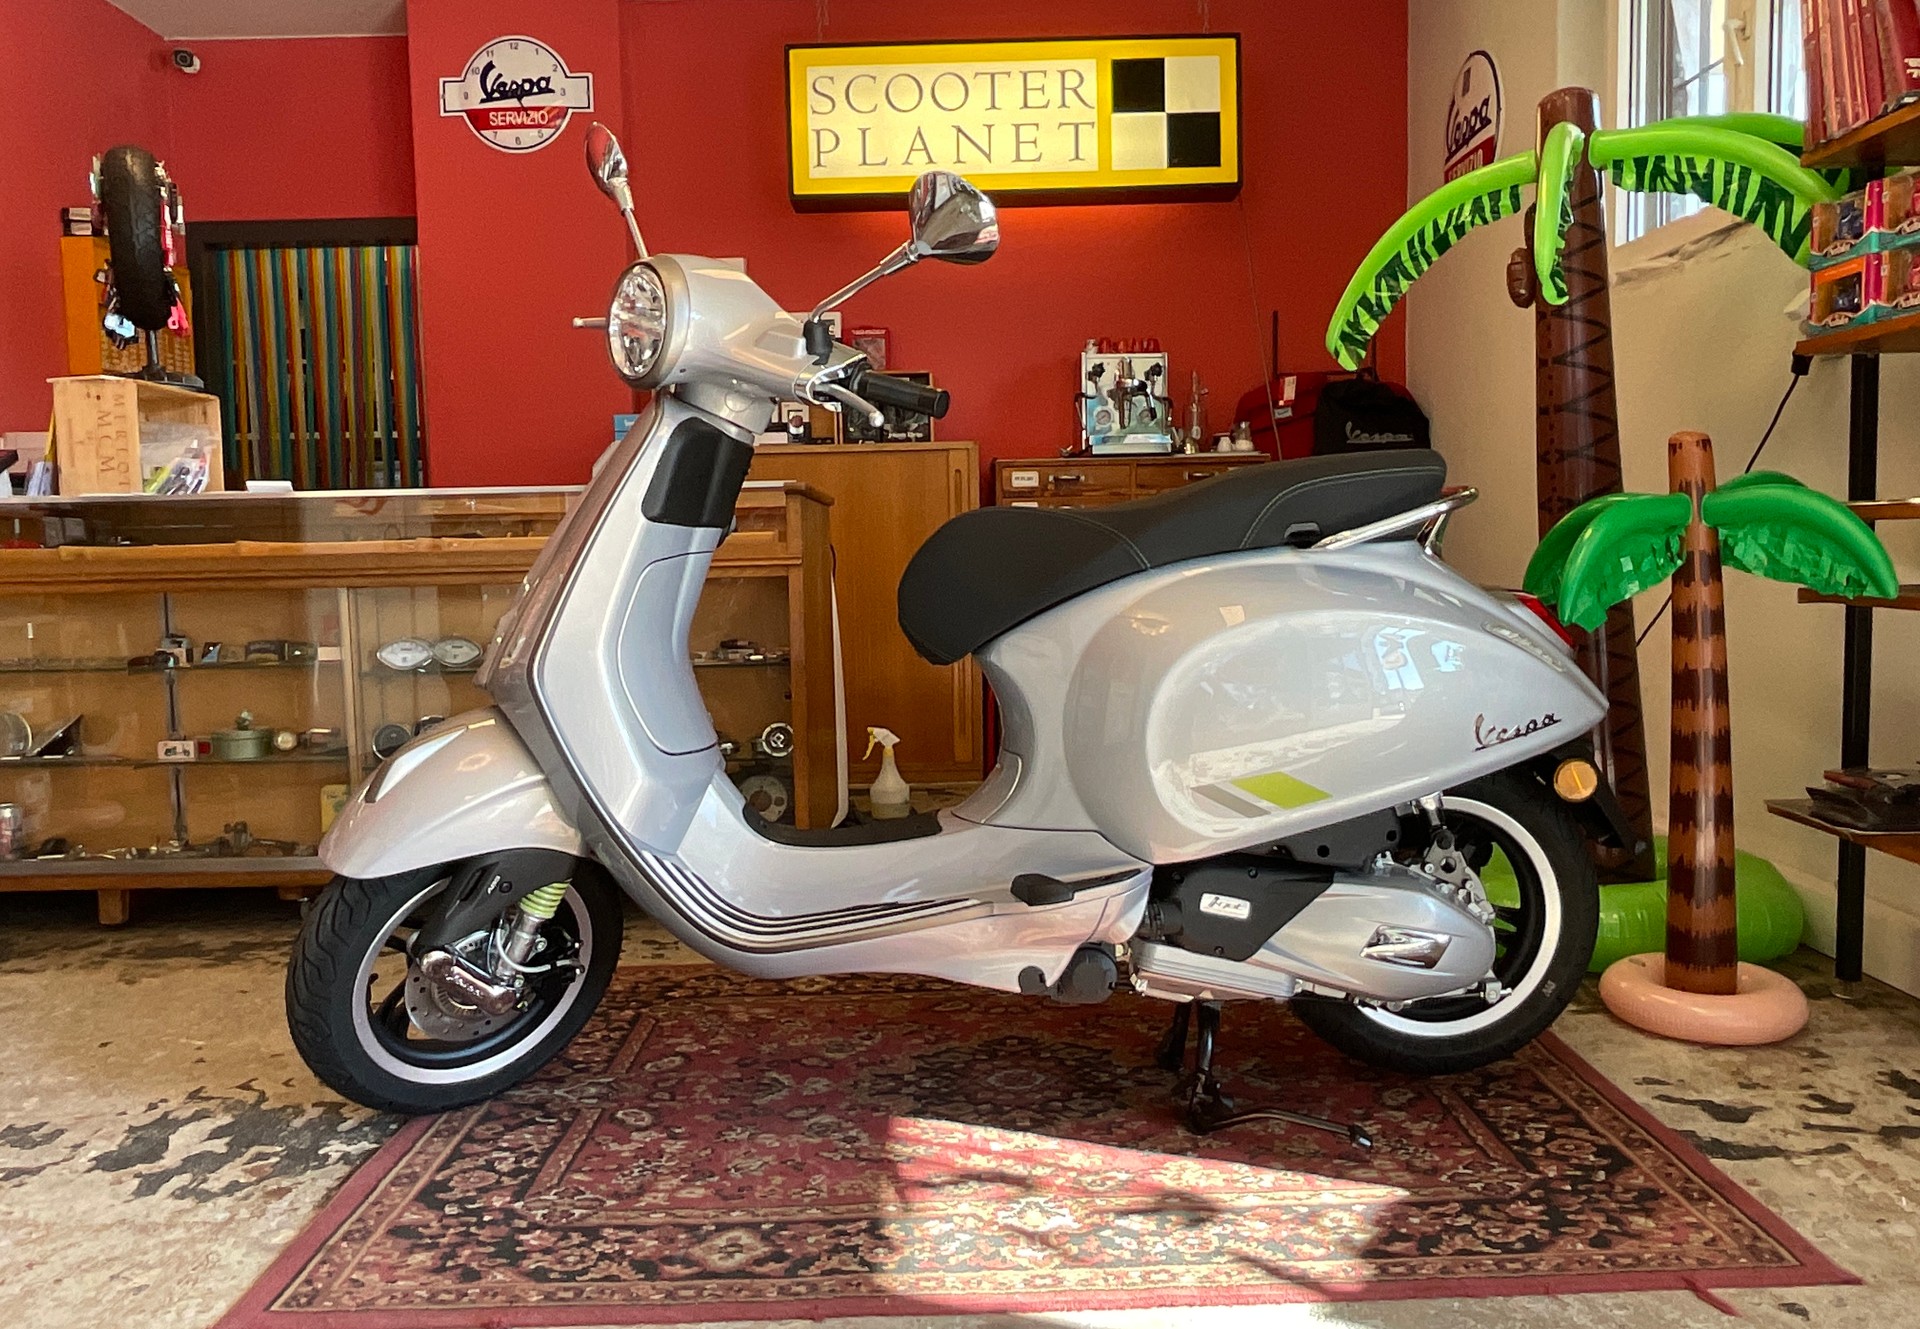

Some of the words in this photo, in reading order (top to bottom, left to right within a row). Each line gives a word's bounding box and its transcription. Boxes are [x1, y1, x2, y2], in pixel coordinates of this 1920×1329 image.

[509, 42, 519, 50] 12
[486, 50, 494, 58] 11
[471, 67, 480, 75] 10
[552, 64, 558, 72] 2
[479, 60, 555, 104] Vespa
[463, 92, 469, 100] 9
[560, 88, 566, 96] 3
[810, 68, 1096, 116] SCOOTER
[489, 110, 549, 126] SERVIZIO
[538, 130, 544, 138] 5
[1445, 94, 1492, 166] Vespa
[493, 131, 498, 140] 7
[515, 136, 522, 146] 6
[811, 121, 1096, 169] PLANET
[1345, 420, 1414, 443] Vespa
[1472, 713, 1562, 751] Vespa
